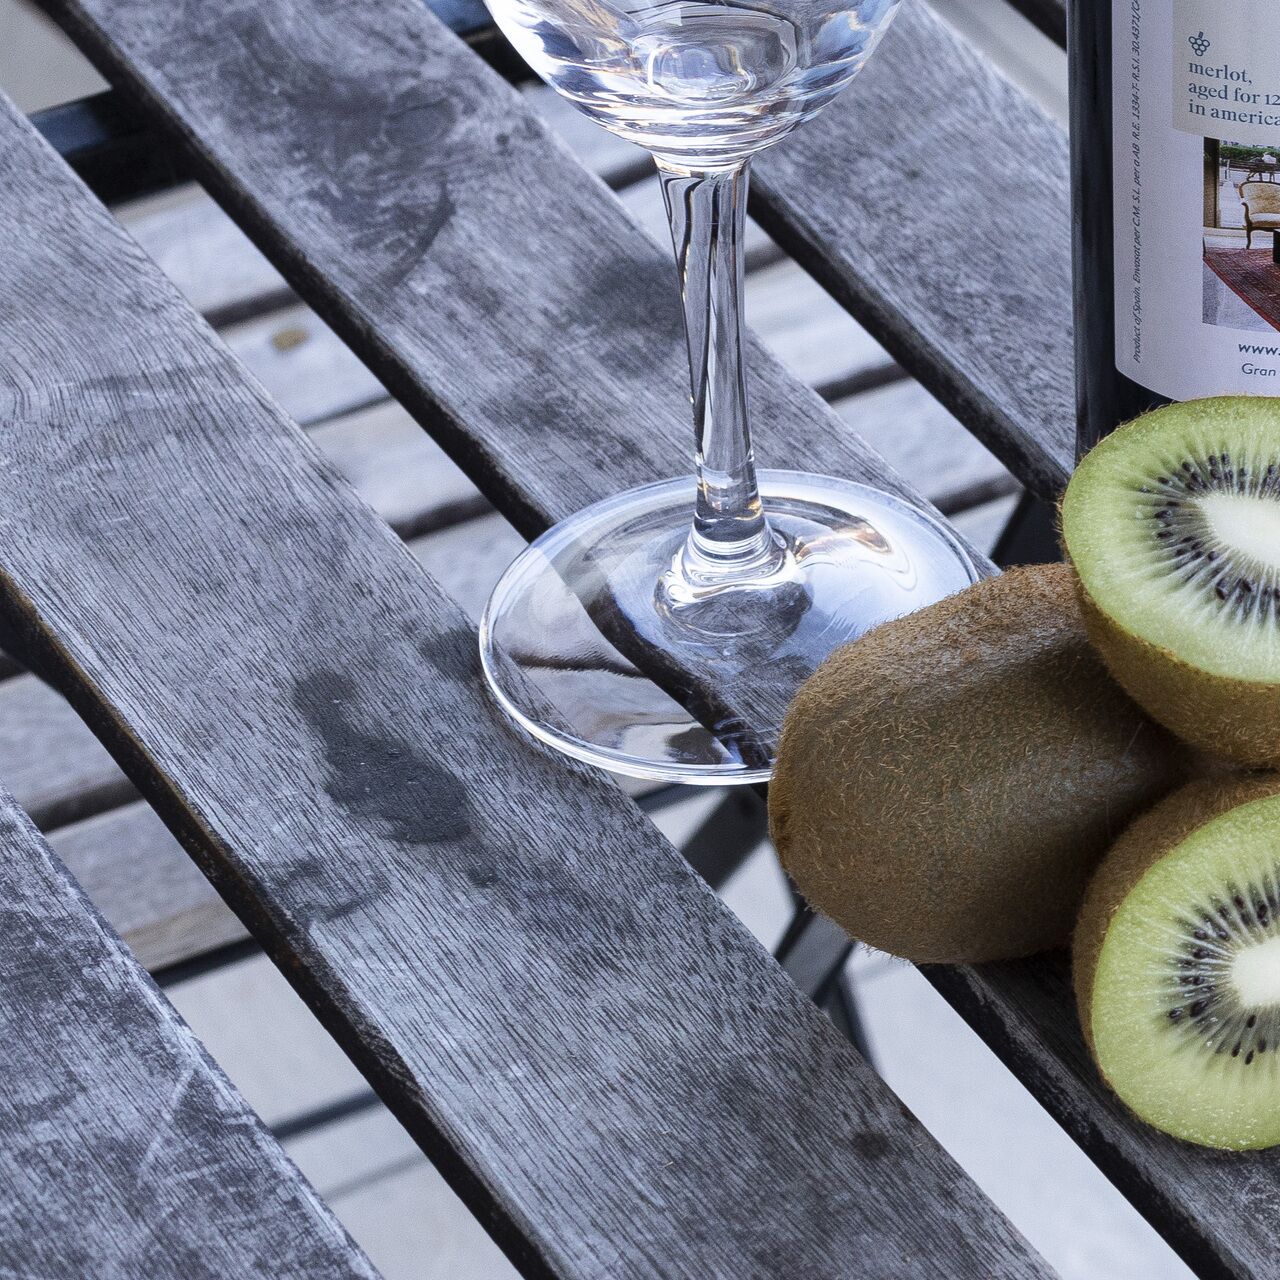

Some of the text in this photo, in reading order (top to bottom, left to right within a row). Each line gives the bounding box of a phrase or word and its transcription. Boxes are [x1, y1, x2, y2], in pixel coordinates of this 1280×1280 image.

[1188, 62, 1253, 86] merlot,
[1188, 82, 1229, 100] aged
[1233, 88, 1260, 104] for
[1188, 99, 1205, 116] in
[1131, 122, 1141, 141] R.E.
[1131, 143, 1141, 159] AB
[1131, 168, 1142, 187] per
[1131, 206, 1141, 227] C.M.
[1132, 227, 1142, 247] per
[1132, 245, 1141, 284] Envasat
[1132, 326, 1142, 363] Product
[1241, 362, 1276, 377] Gran
